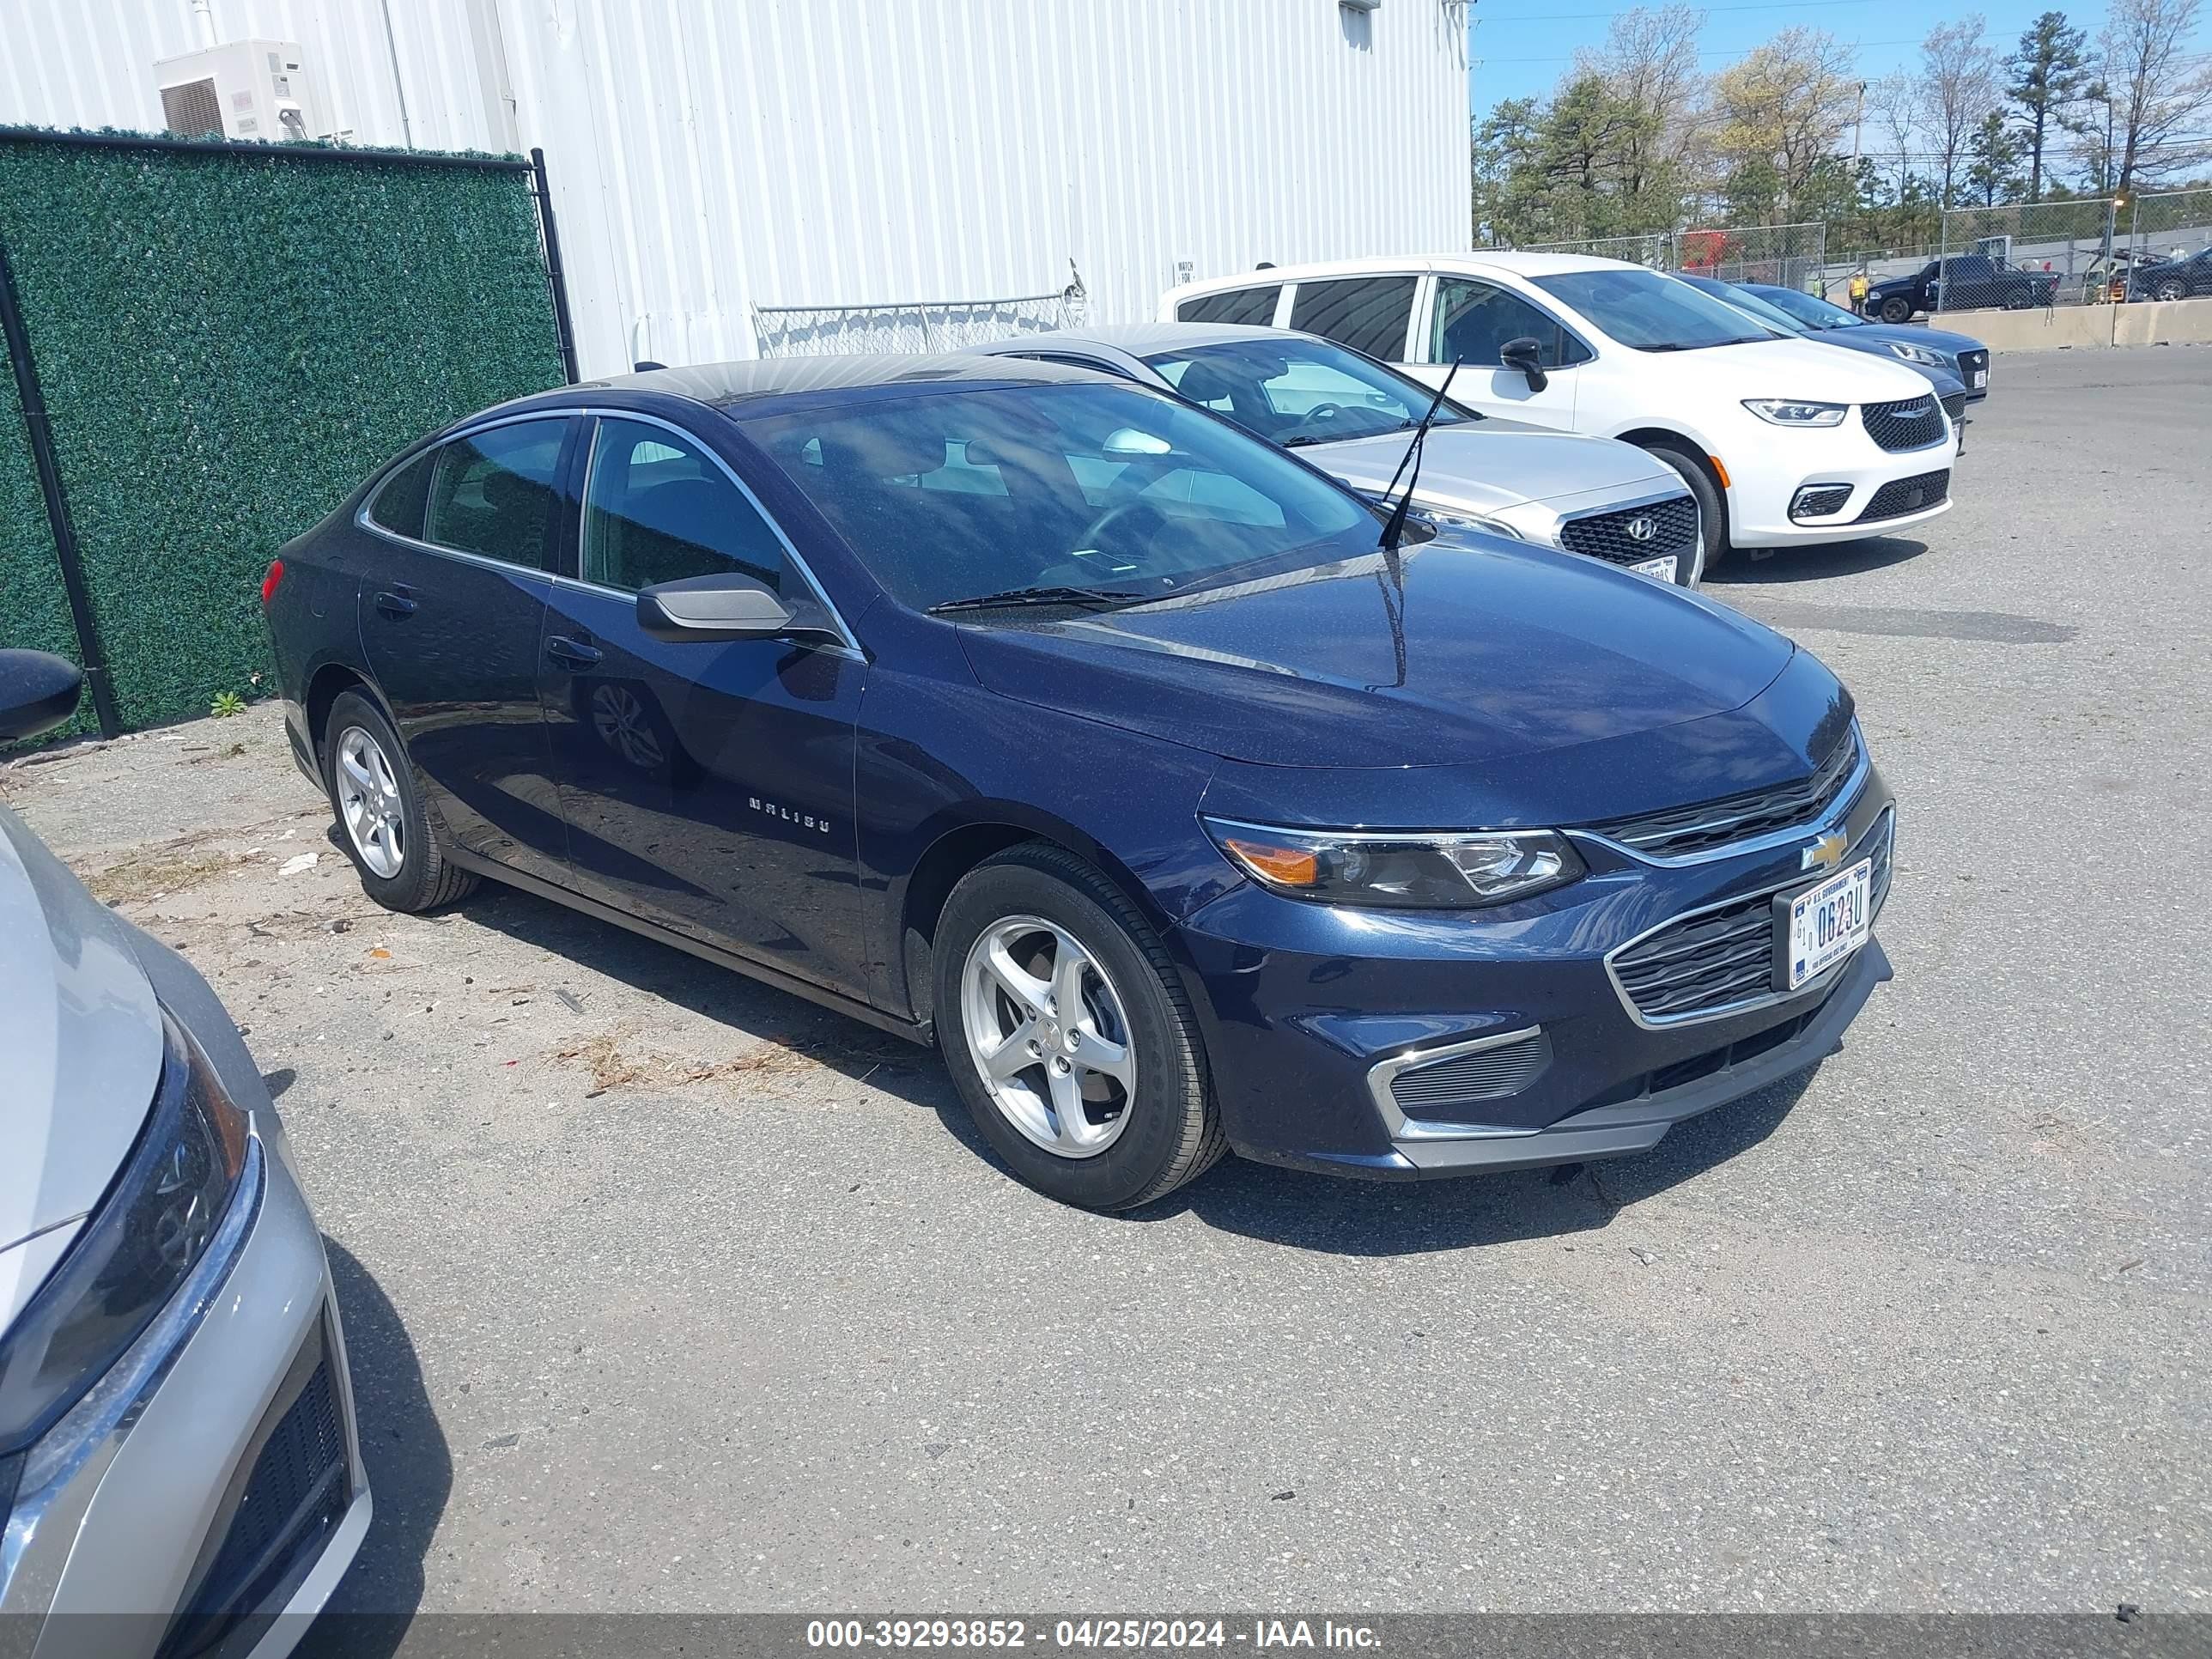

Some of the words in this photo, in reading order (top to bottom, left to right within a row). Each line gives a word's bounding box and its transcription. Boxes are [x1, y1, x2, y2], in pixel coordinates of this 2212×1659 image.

[1177, 261, 1193, 271] WATCH
[749, 797, 830, 833] MALIBU
[1819, 884, 1863, 948] 0623U
